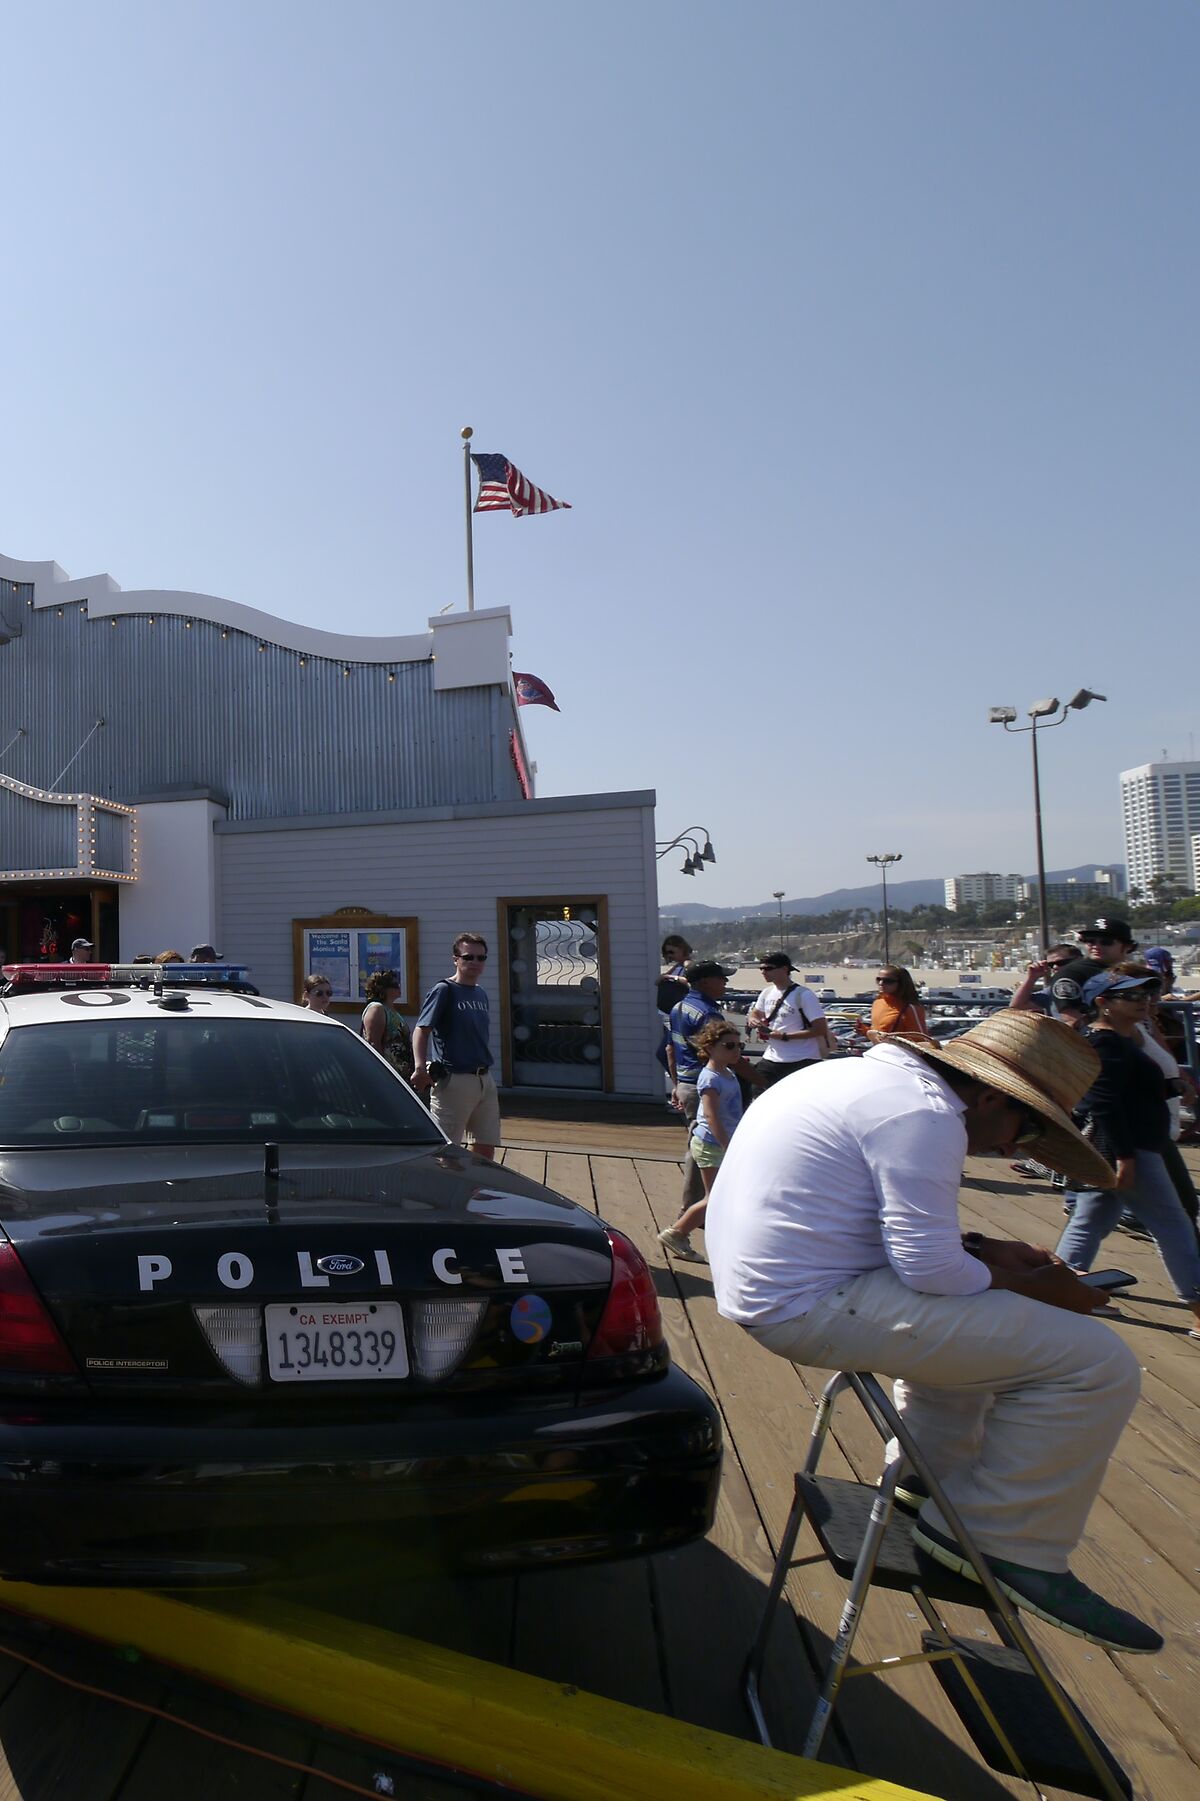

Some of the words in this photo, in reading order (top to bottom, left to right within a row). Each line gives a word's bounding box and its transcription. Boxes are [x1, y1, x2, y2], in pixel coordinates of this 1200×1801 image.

[137, 1248, 530, 1292] POLICE
[328, 1259, 354, 1270] Ford
[300, 1314, 316, 1325] CA
[322, 1313, 369, 1325] EXEMPT
[279, 1330, 396, 1369] 1348339
